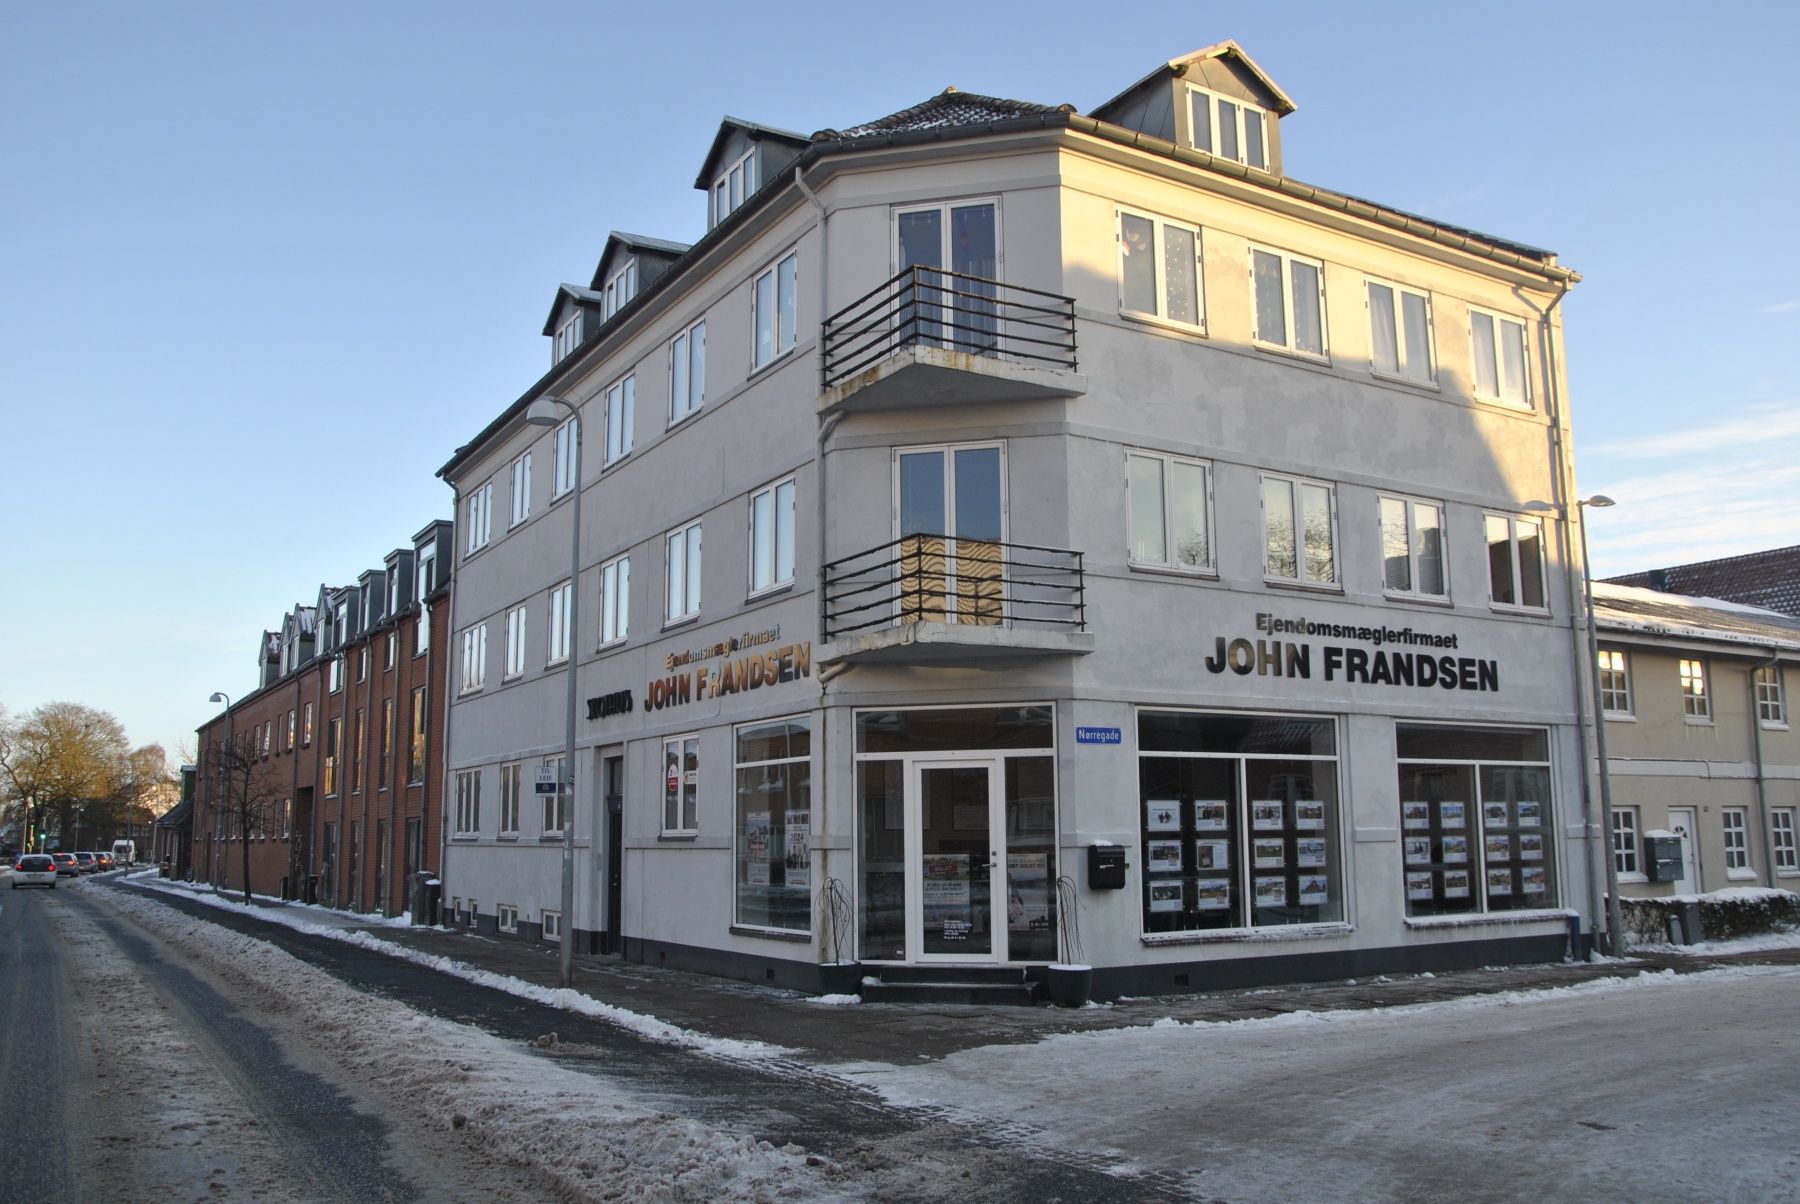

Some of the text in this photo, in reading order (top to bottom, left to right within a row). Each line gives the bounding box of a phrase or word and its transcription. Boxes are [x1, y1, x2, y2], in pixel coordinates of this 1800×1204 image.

[665, 624, 781, 672] Ejendomsmæglerfirmaet
[1255, 612, 1458, 650] Ejendomsmæglerfirmaet
[644, 671, 691, 712] JOHN
[695, 641, 811, 701] FRANDSEN
[1205, 636, 1499, 692] JOHN FRANDSEN
[1078, 729, 1119, 743] Nørregade
